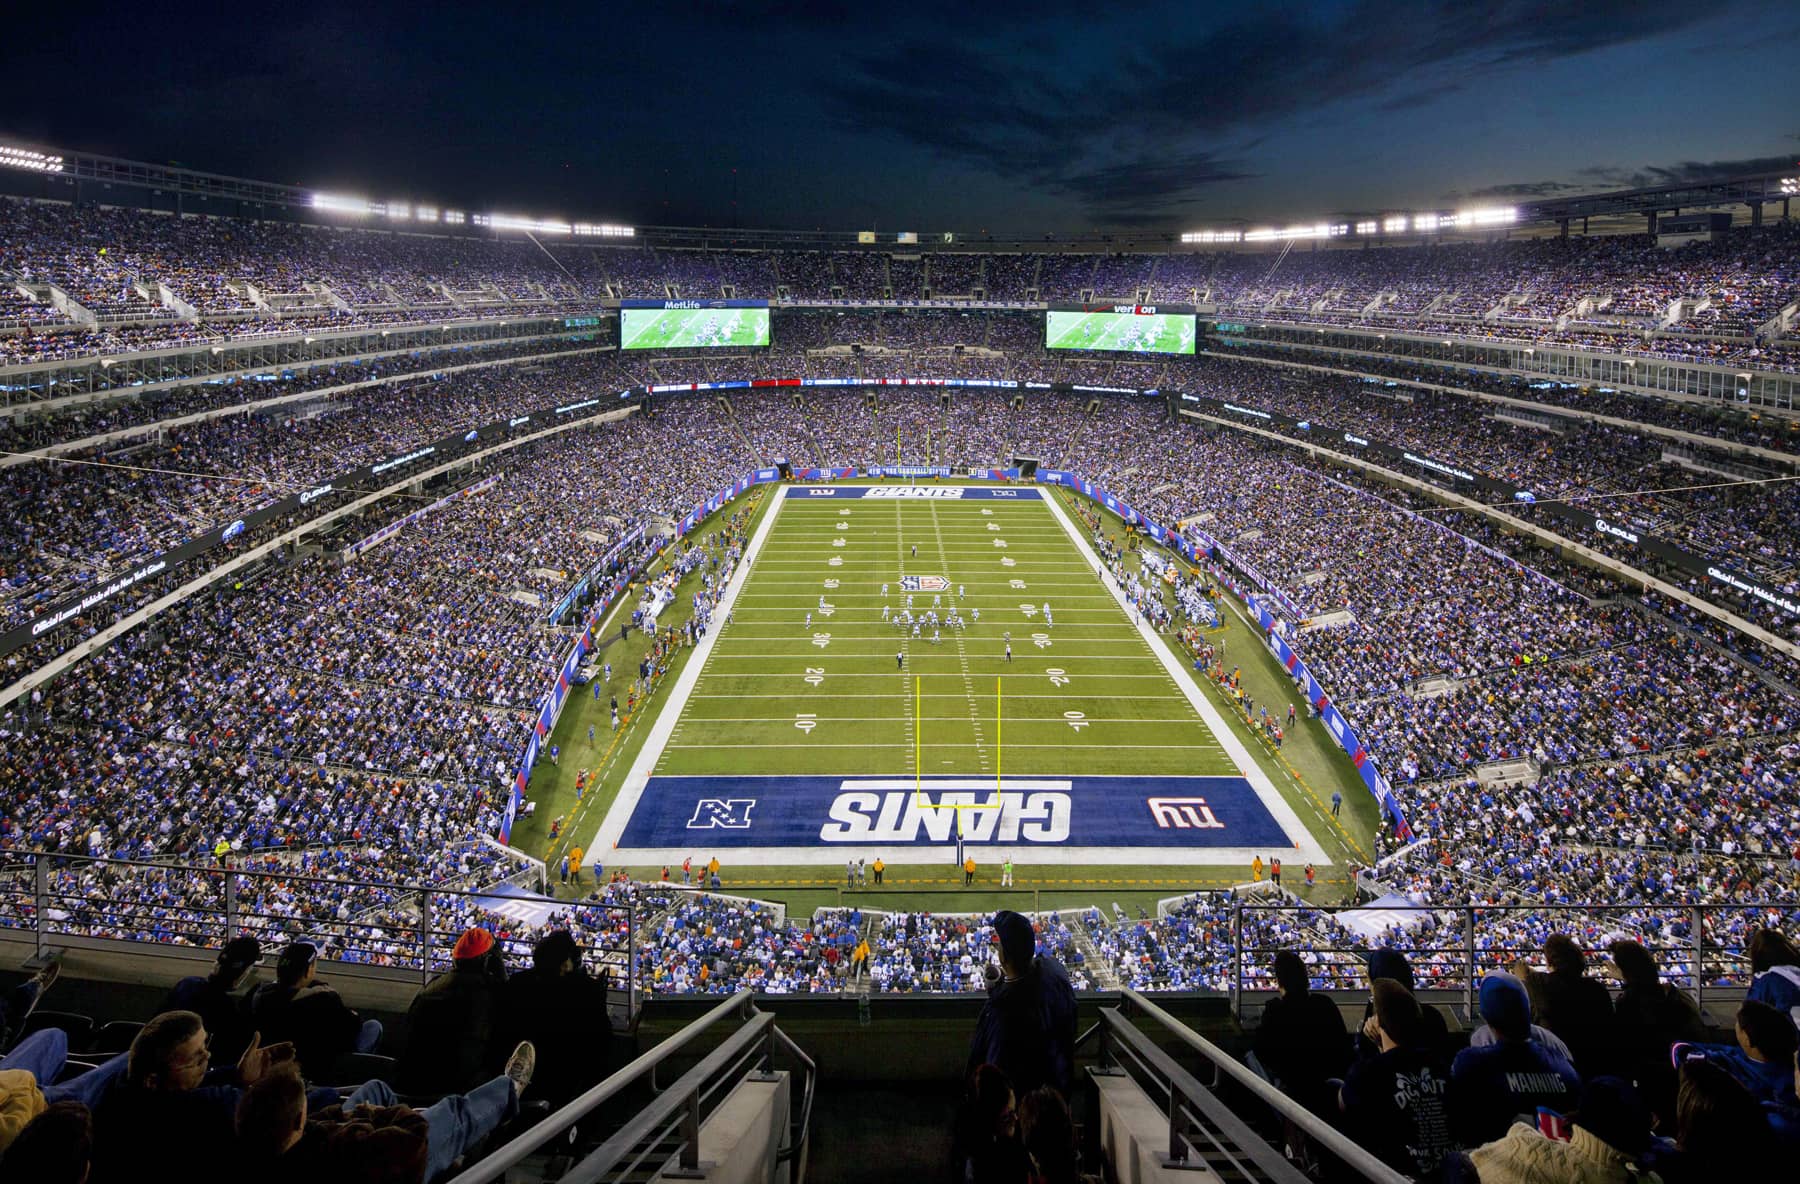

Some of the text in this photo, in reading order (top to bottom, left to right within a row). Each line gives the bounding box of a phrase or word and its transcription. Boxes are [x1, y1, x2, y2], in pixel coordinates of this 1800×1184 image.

[665, 300, 700, 309] MetLife
[865, 487, 964, 497] GIANTS
[1606, 525, 1638, 543] LEXUS
[1707, 567, 1731, 583] Official
[1730, 576, 1753, 594] Luxury
[1753, 586, 1776, 604] Vehicle
[32, 613, 59, 635] Official
[58, 604, 82, 622] Luxury
[81, 592, 104, 609] Vehicle
[120, 576, 133, 588] New
[133, 569, 147, 582] York
[147, 560, 166, 575] Giants
[1031, 633, 1052, 646] 30
[804, 667, 825, 682] 20
[1046, 668, 1070, 684] 20
[794, 713, 817, 729] 10
[1063, 711, 1089, 727] 10
[819, 792, 1072, 842] GIANTS
[1420, 1078, 1448, 1096] OUT
[1505, 1072, 1567, 1093] MANNING
